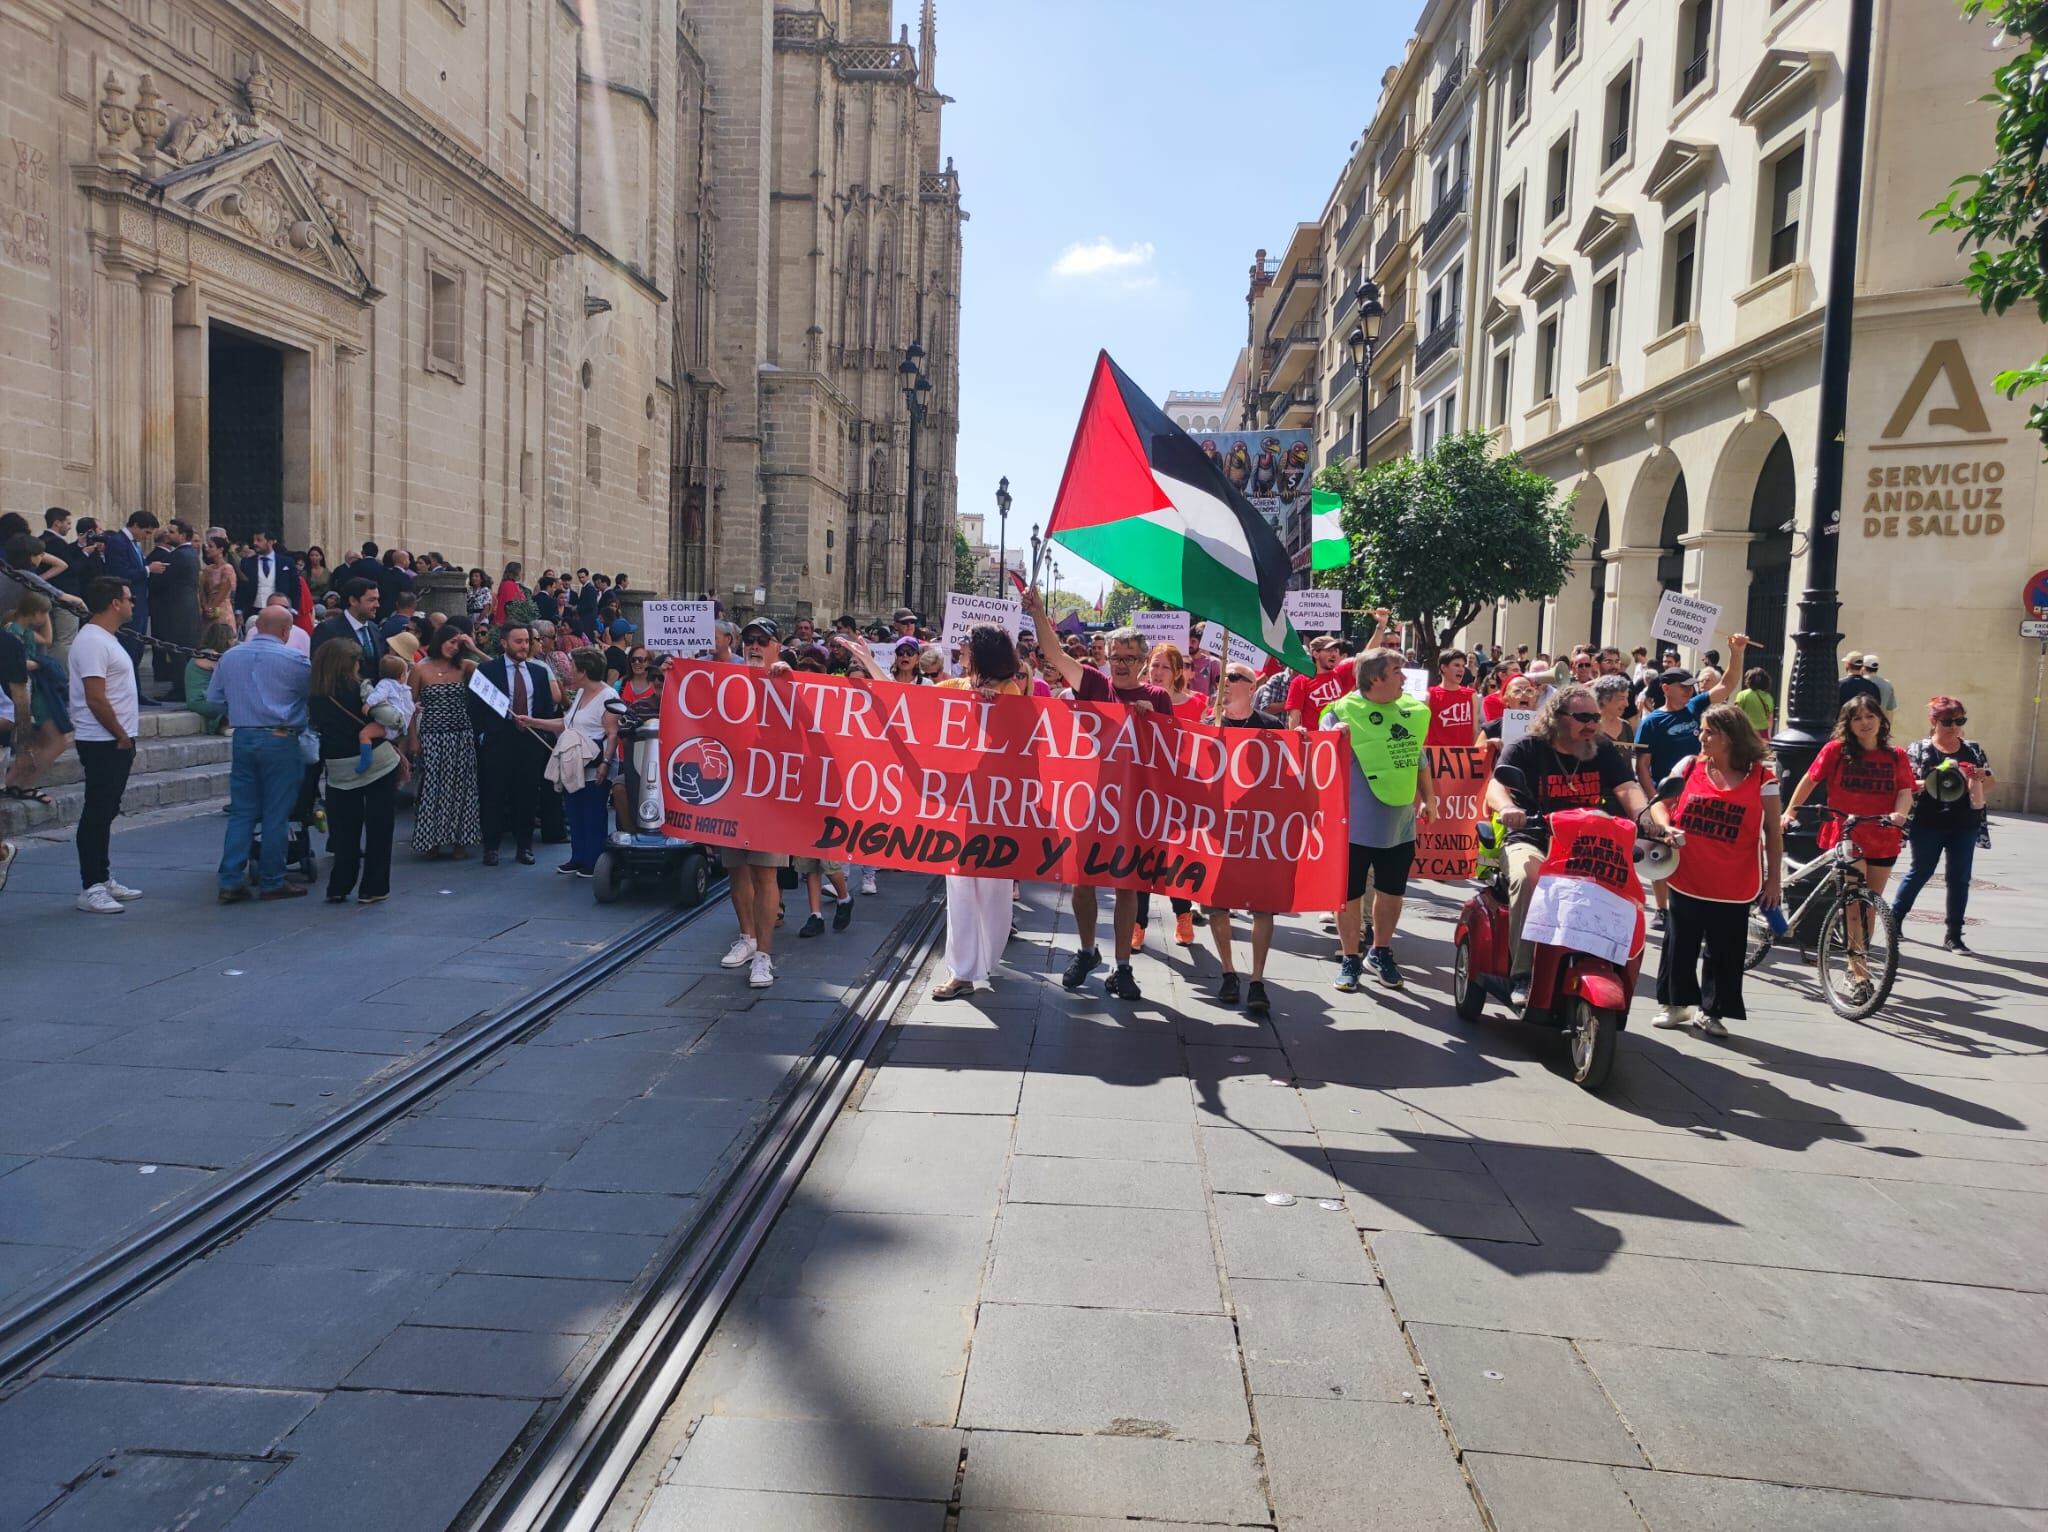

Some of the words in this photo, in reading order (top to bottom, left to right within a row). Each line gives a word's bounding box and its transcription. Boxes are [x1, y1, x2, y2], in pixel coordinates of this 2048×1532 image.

[1867, 461, 2005, 488] SERVICIO
[1863, 487, 2003, 513] ANDALUZ
[1863, 516, 1900, 538] DE
[1907, 513, 2005, 537] SALUD
[951, 596, 1008, 611] EDUCACIÓN
[1011, 604, 1018, 612] Y
[1667, 594, 1682, 604] LOS
[1683, 599, 1718, 615] BARRIOS
[663, 615, 675, 623] DE
[678, 615, 696, 623] LUZ
[961, 611, 1004, 624] SANIDAD
[1670, 607, 1707, 624] OBREROS
[1663, 628, 1699, 645] DIGNIDAD
[1666, 618, 1703, 635] EXIGIMOS
[678, 670, 920, 745] CONTRA
[934, 697, 1009, 754] EL
[1019, 707, 1337, 791] ABANDONO
[1394, 759, 1417, 768] SEVILL
[742, 748, 803, 803] DE
[816, 757, 904, 815] LOS
[916, 768, 1122, 835] BARRIOS
[1136, 789, 1324, 862] OBREROS
[1446, 795, 1477, 819] SUS
[695, 816, 738, 837] HARTOS
[1681, 814, 1739, 839] HARTO
[1424, 833, 1433, 849] Y
[1434, 833, 1480, 851] SANIDA
[812, 816, 1019, 869] DIGNIDAD
[1036, 837, 1072, 876] Y
[1084, 842, 1207, 893] LUCHA
[1414, 858, 1427, 874] Y
[1431, 858, 1477, 876] CAPI
